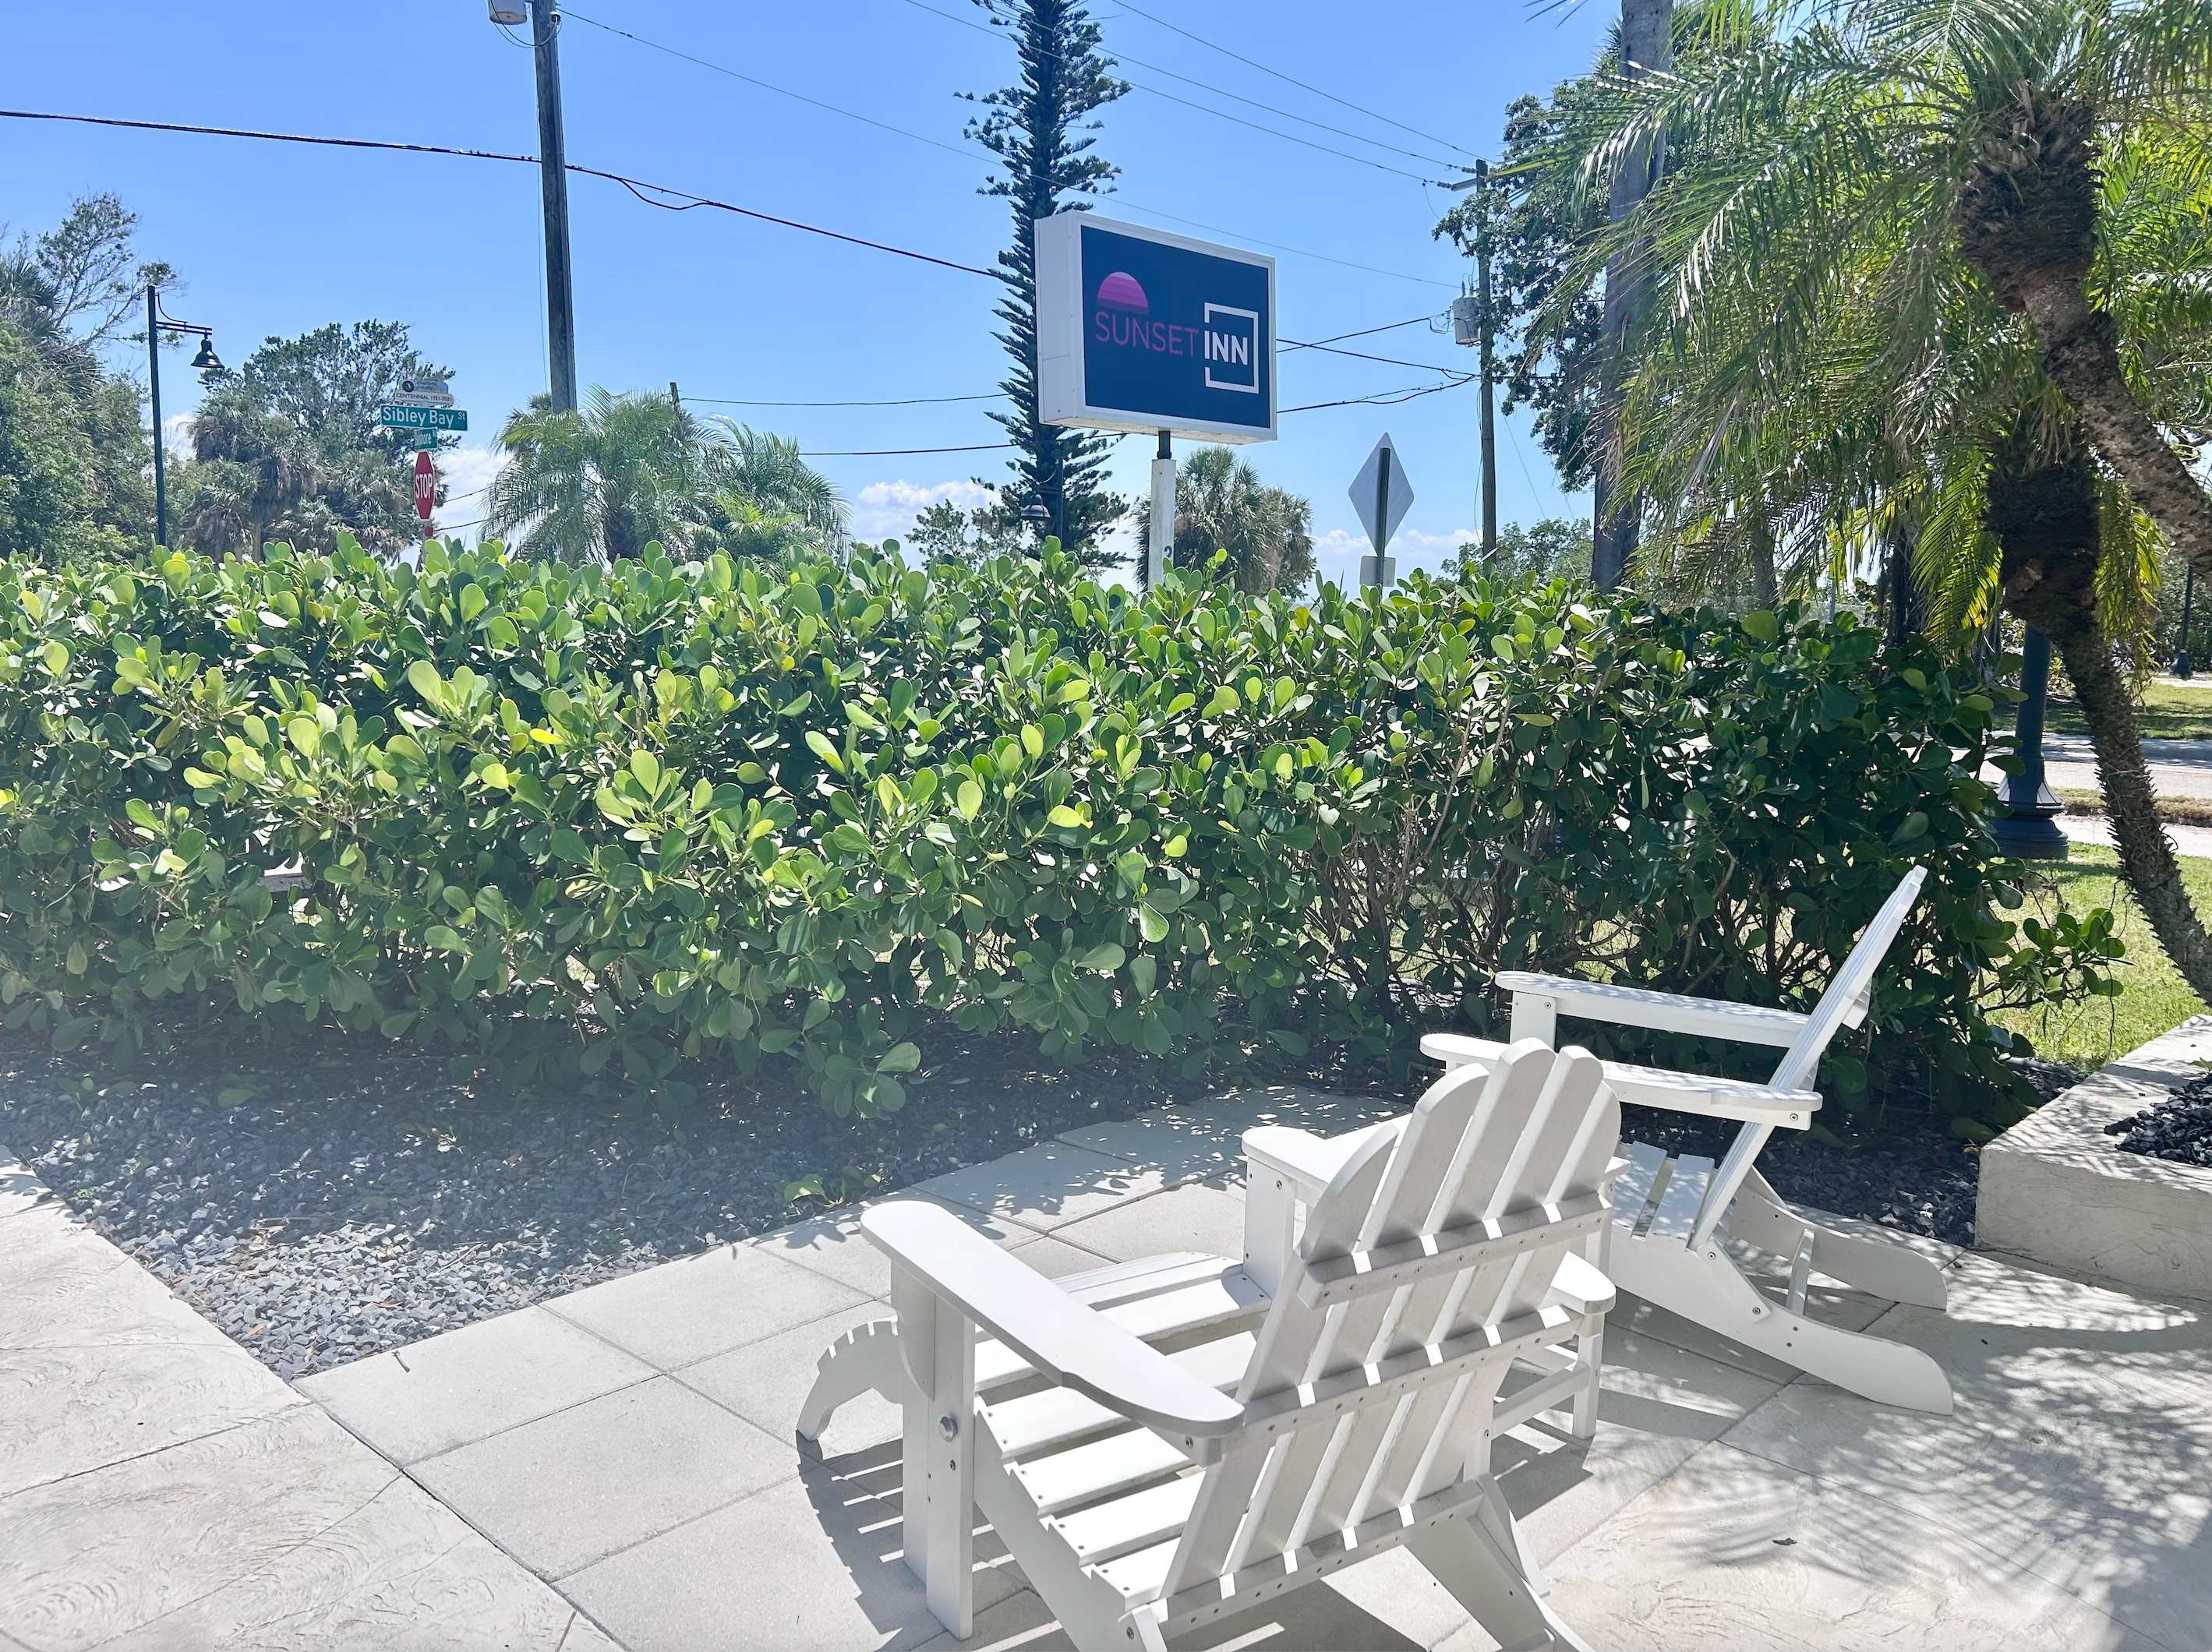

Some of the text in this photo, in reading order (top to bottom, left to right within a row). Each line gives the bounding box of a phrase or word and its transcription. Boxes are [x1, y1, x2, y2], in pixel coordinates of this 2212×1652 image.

[1094, 311, 1248, 366] SUNSET INN
[383, 406, 466, 429] Sibley Bay St
[415, 473, 433, 499] STOP
